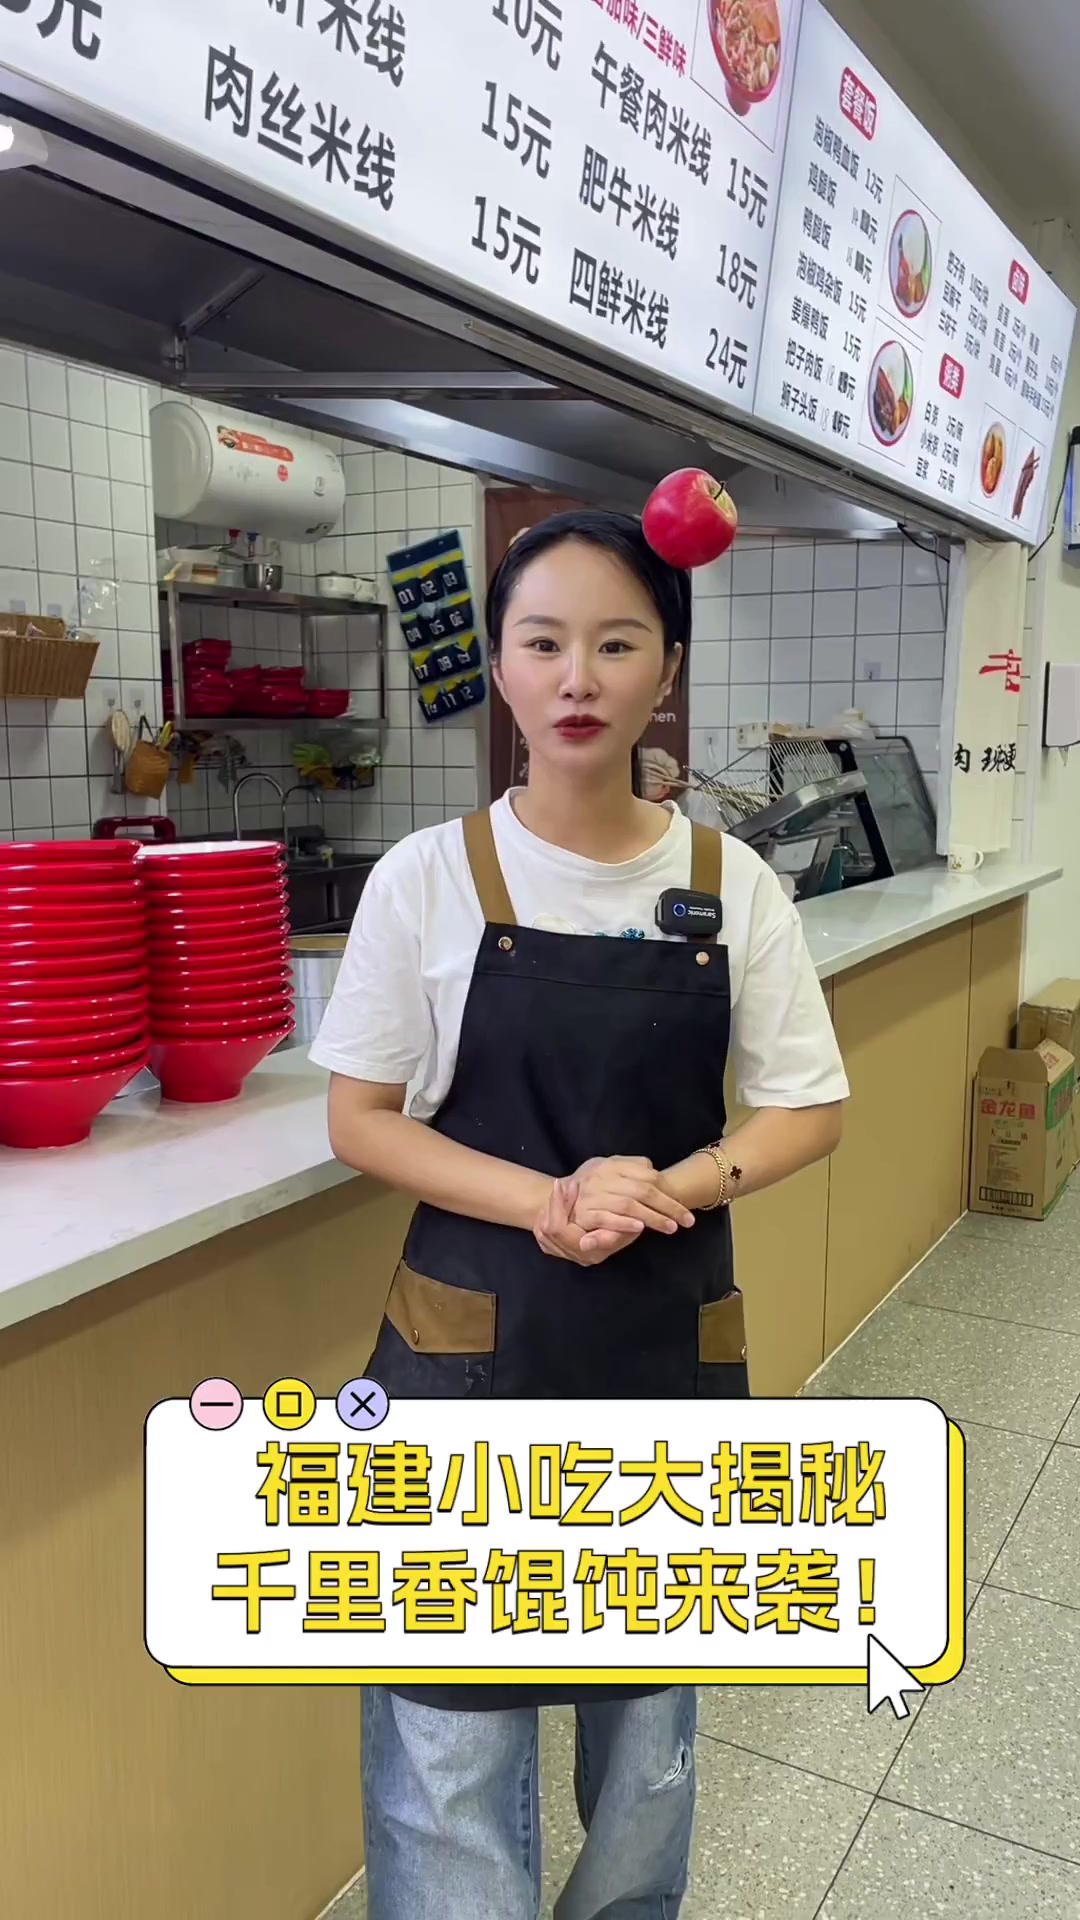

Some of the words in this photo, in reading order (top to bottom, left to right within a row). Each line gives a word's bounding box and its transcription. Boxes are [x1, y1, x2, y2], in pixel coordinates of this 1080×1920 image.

[0, 0, 102, 60] 元
[482, 81, 552, 179] 15元
[841, 72, 876, 137] 套餐饭
[591, 41, 712, 186] 午餐肉米线
[727, 157, 768, 229] 15元
[204, 45, 396, 211] 肉丝米线
[471, 196, 540, 284] 15元
[865, 167, 884, 205] 12元
[578, 144, 680, 261] 肥牛米线
[716, 244, 757, 310] 18元
[569, 247, 669, 350] 四鲜米线
[705, 328, 748, 389] 24元
[849, 291, 867, 324] 15元
[786, 338, 824, 383] 把子肉饭
[844, 331, 862, 363] 15元
[781, 382, 818, 424] 狮子头饭
[397, 588, 415, 605] 01
[420, 580, 437, 596] 02
[442, 571, 458, 587] 03
[405, 627, 422, 643] 04
[429, 619, 445, 635] 05
